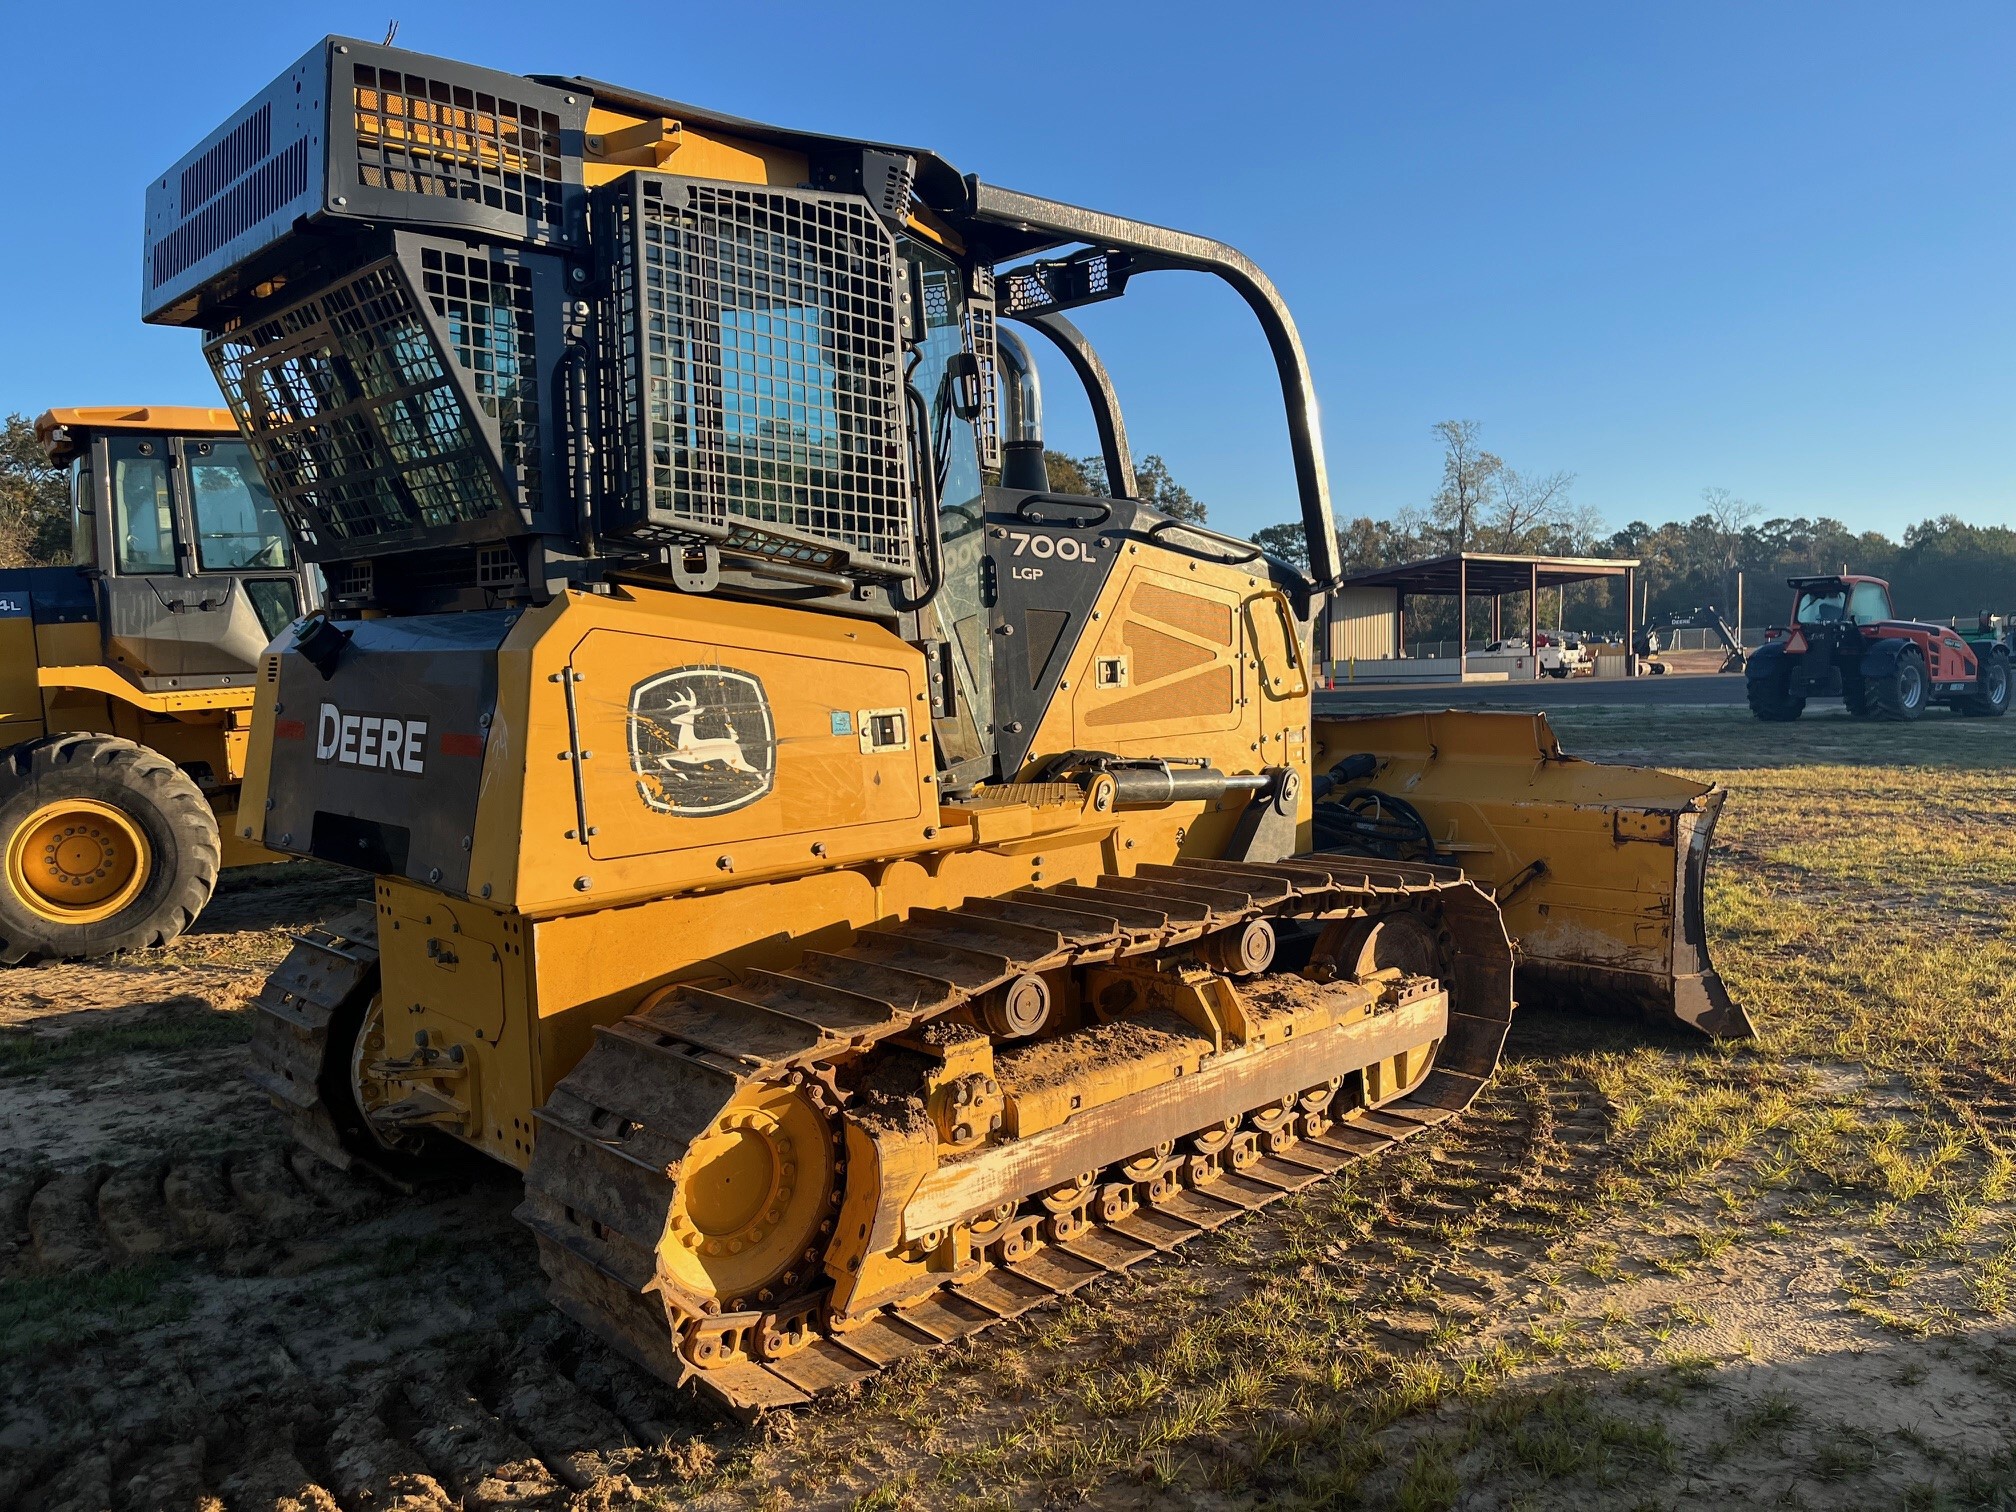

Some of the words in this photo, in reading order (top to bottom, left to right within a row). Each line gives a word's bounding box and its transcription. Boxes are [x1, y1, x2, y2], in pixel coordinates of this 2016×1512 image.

[1009, 532, 1097, 564] 700L
[1012, 566, 1044, 581] LGP
[316, 702, 428, 774] DEERE
